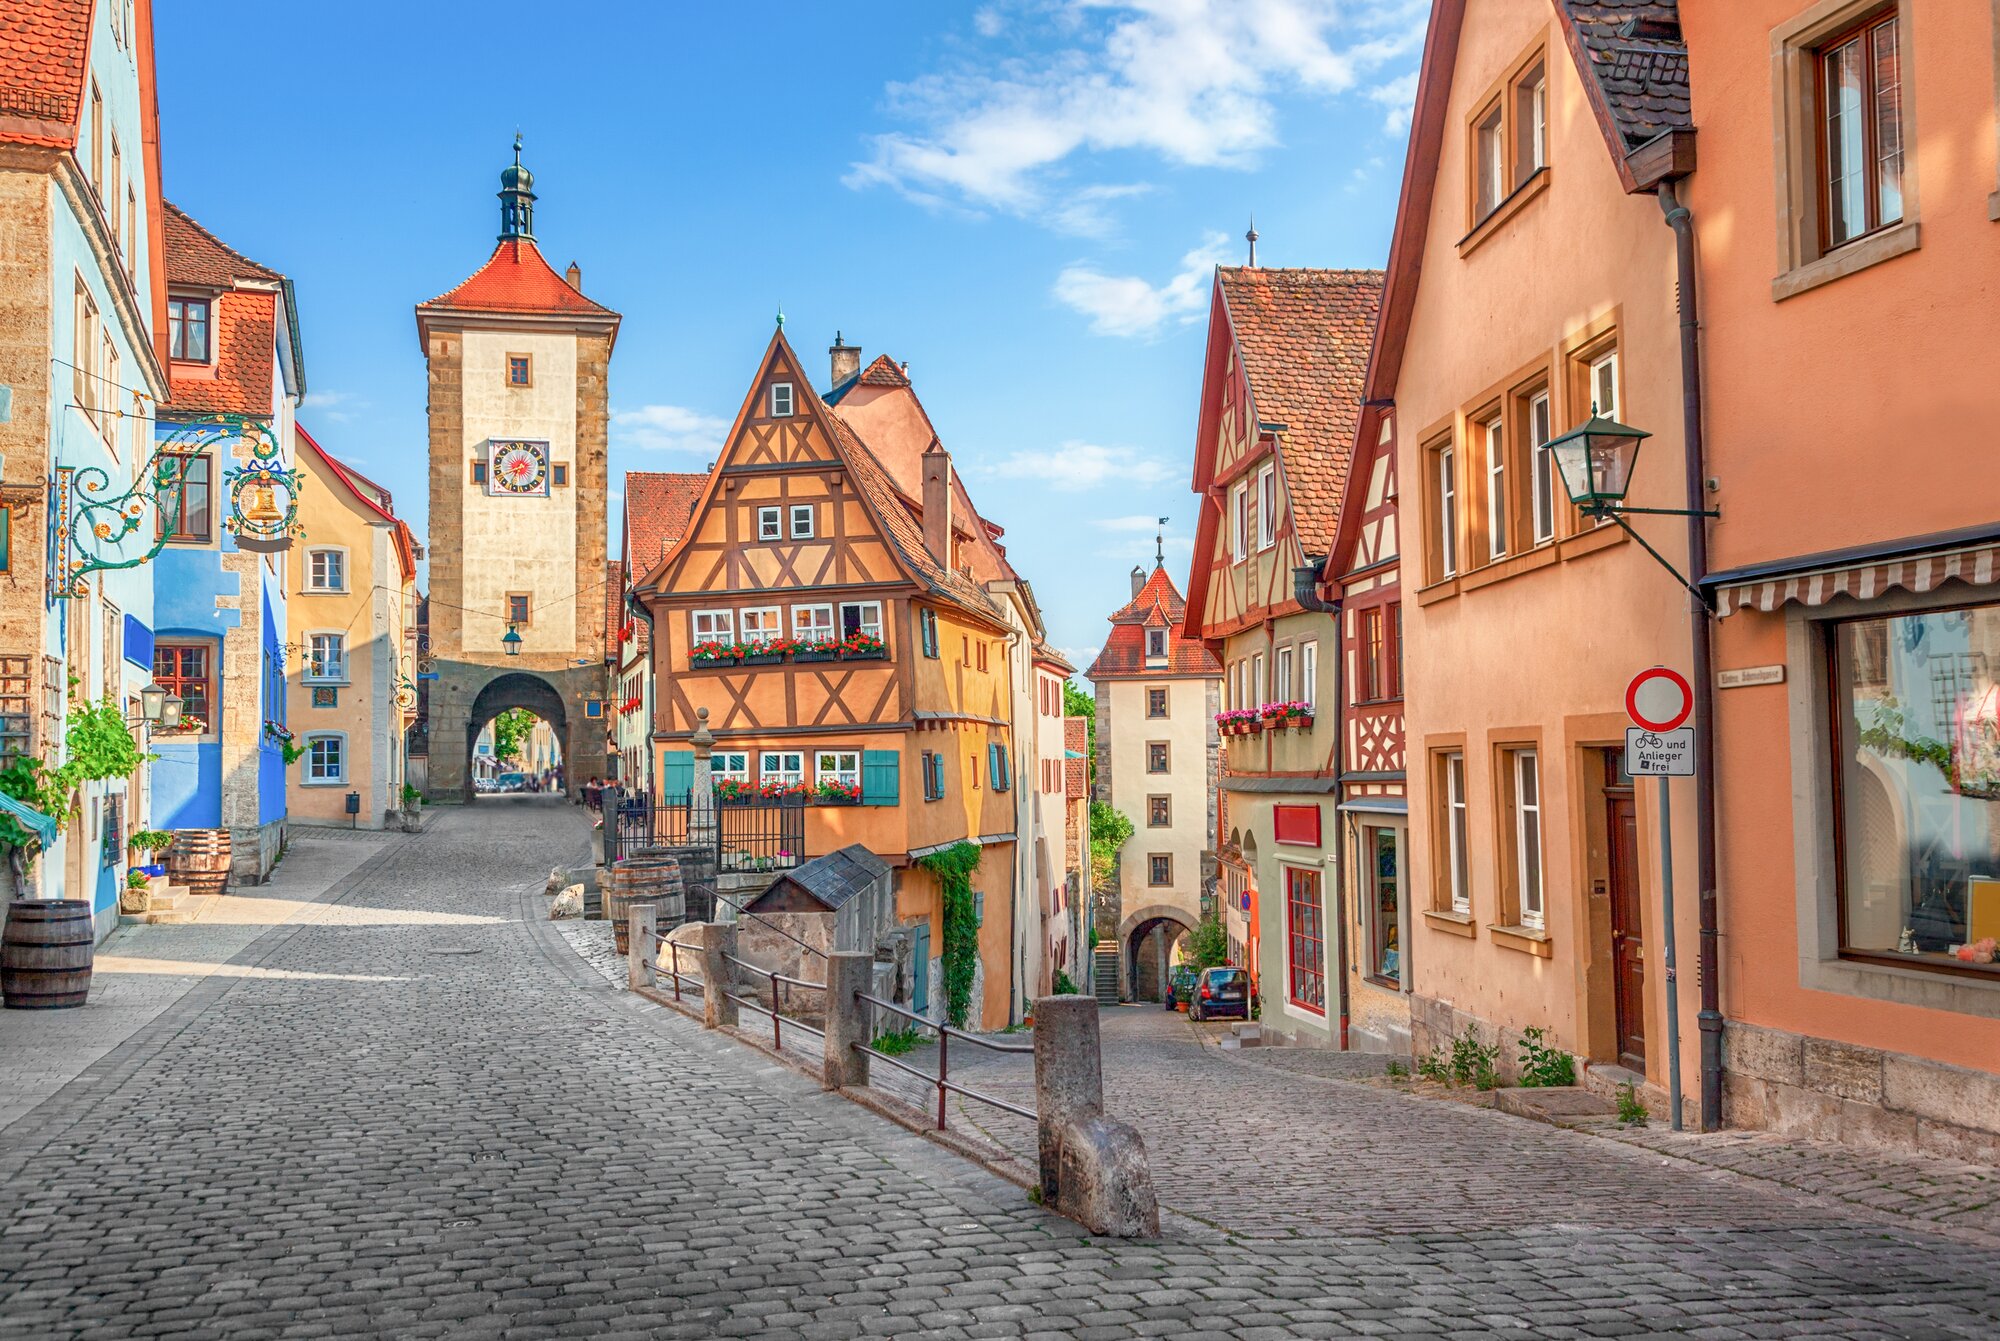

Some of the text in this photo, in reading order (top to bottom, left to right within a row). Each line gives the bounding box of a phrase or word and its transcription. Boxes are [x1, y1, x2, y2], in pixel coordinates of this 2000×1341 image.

[1666, 740, 1686, 749] und
[1638, 751, 1683, 762] Anlieger
[1652, 762, 1670, 771] frei
